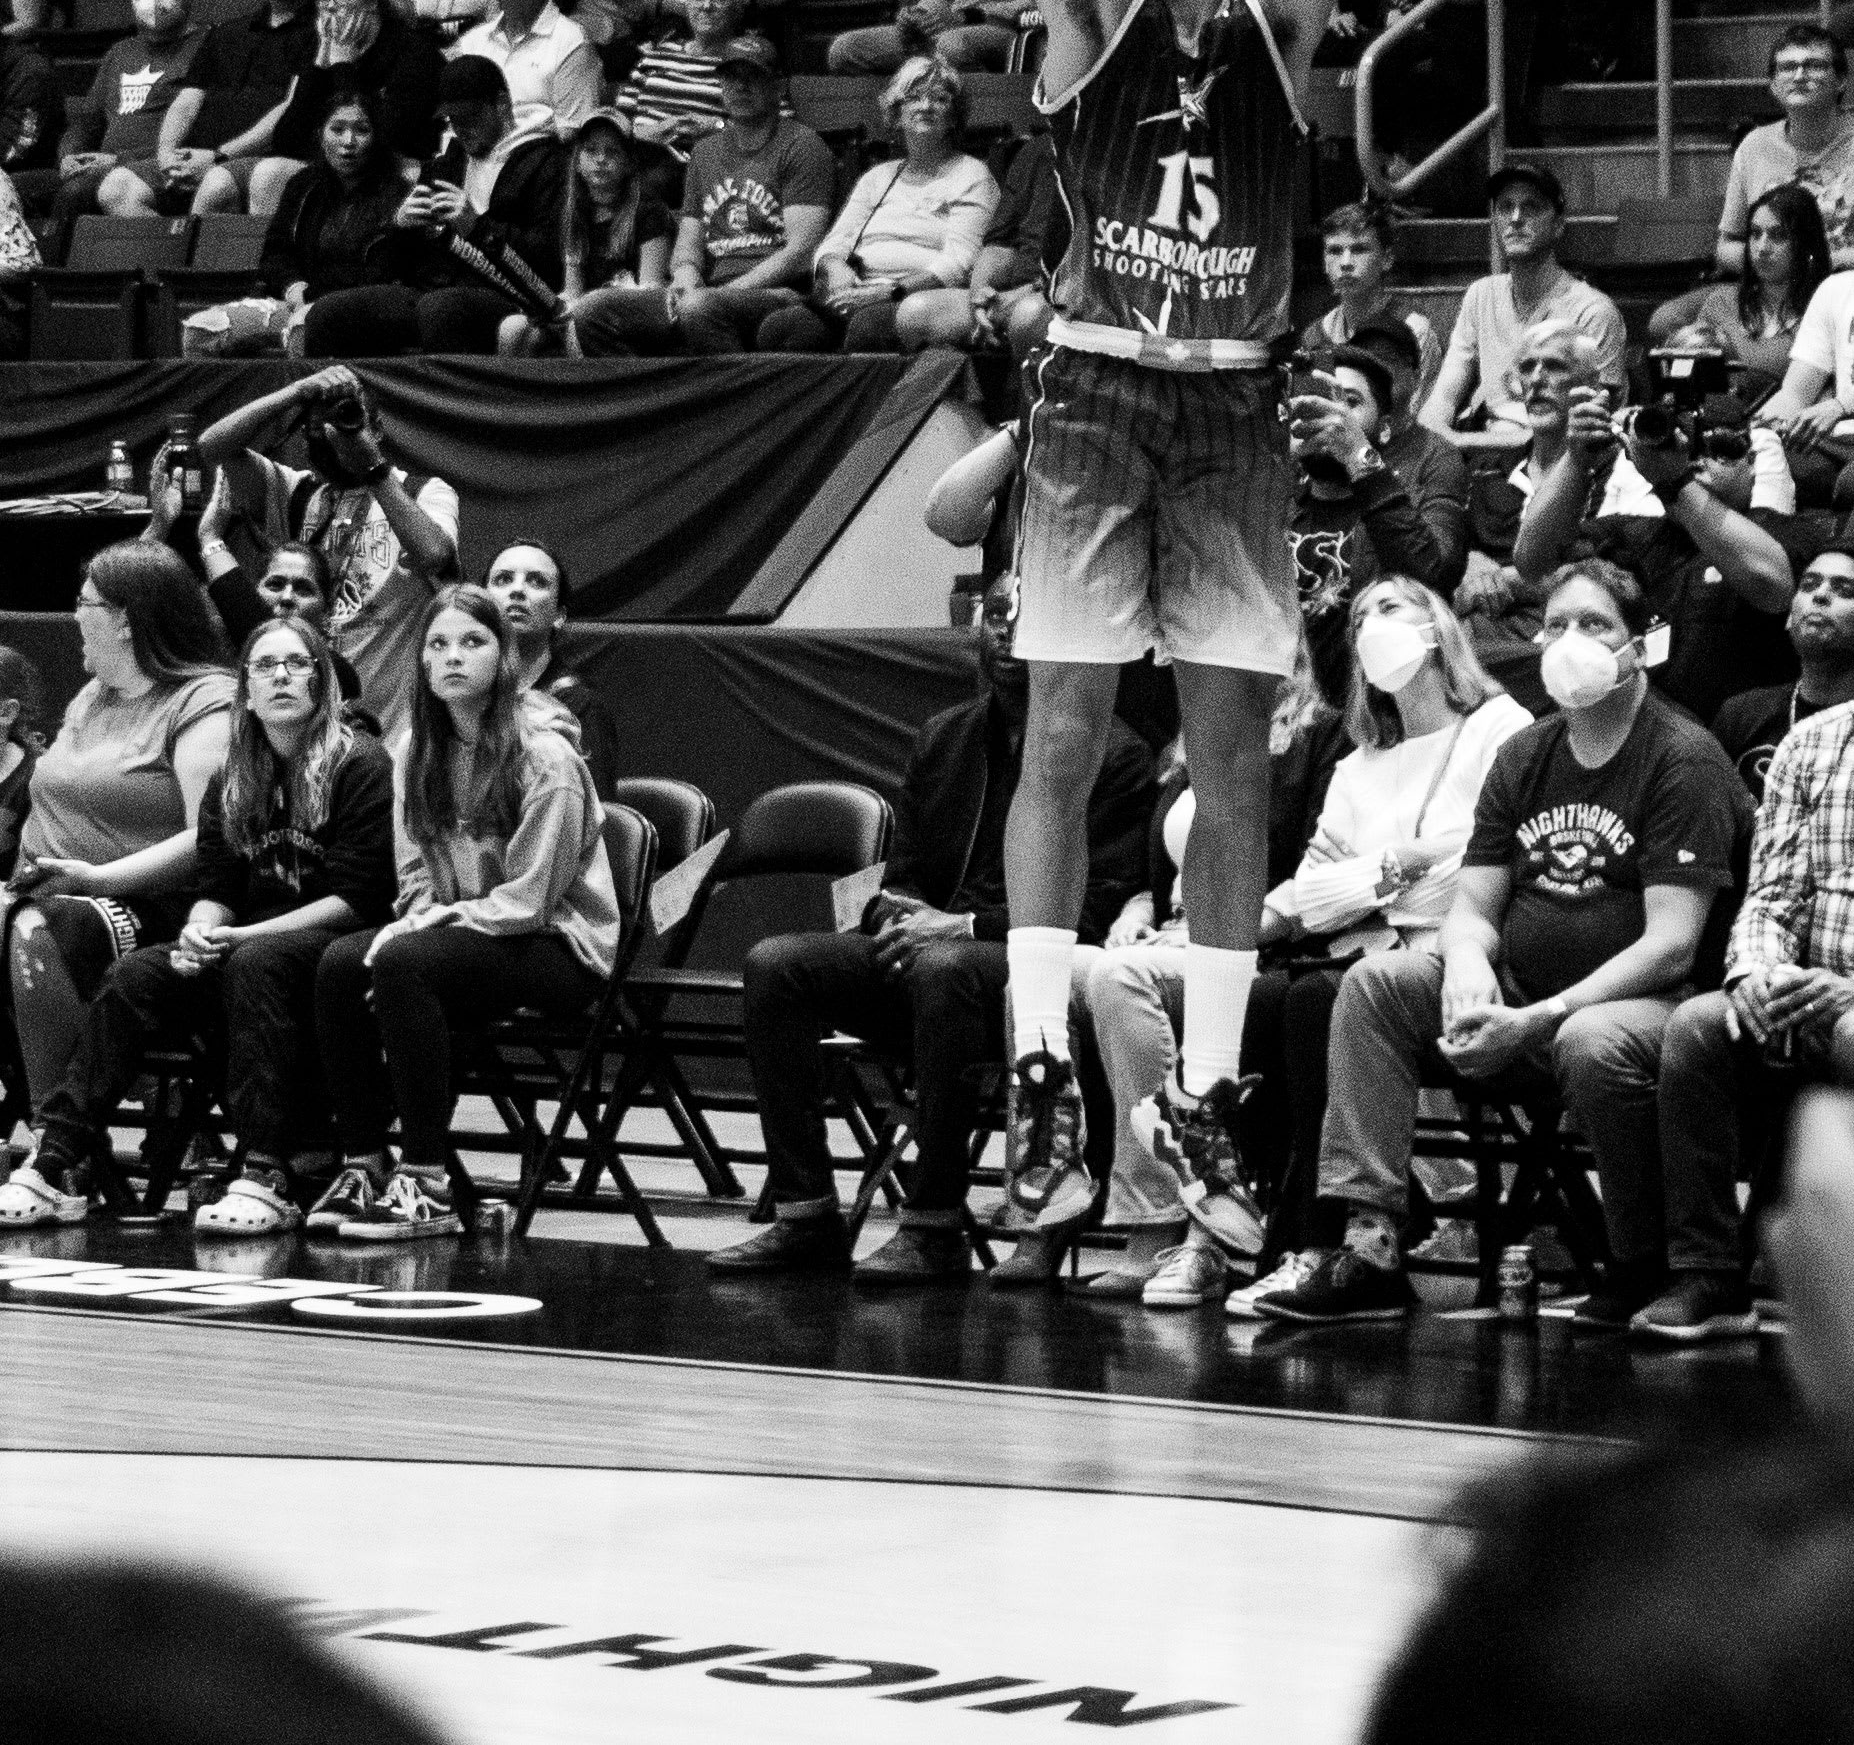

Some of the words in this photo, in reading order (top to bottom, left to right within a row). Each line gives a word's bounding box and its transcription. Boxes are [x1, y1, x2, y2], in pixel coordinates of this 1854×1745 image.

[1147, 150, 1221, 243] 15
[1093, 247, 1190, 295] SHOOTING
[1199, 276, 1248, 301] SARS
[1094, 215, 1258, 280] SCARBOROUGH
[1515, 802, 1636, 856] NIGHTHAWKS
